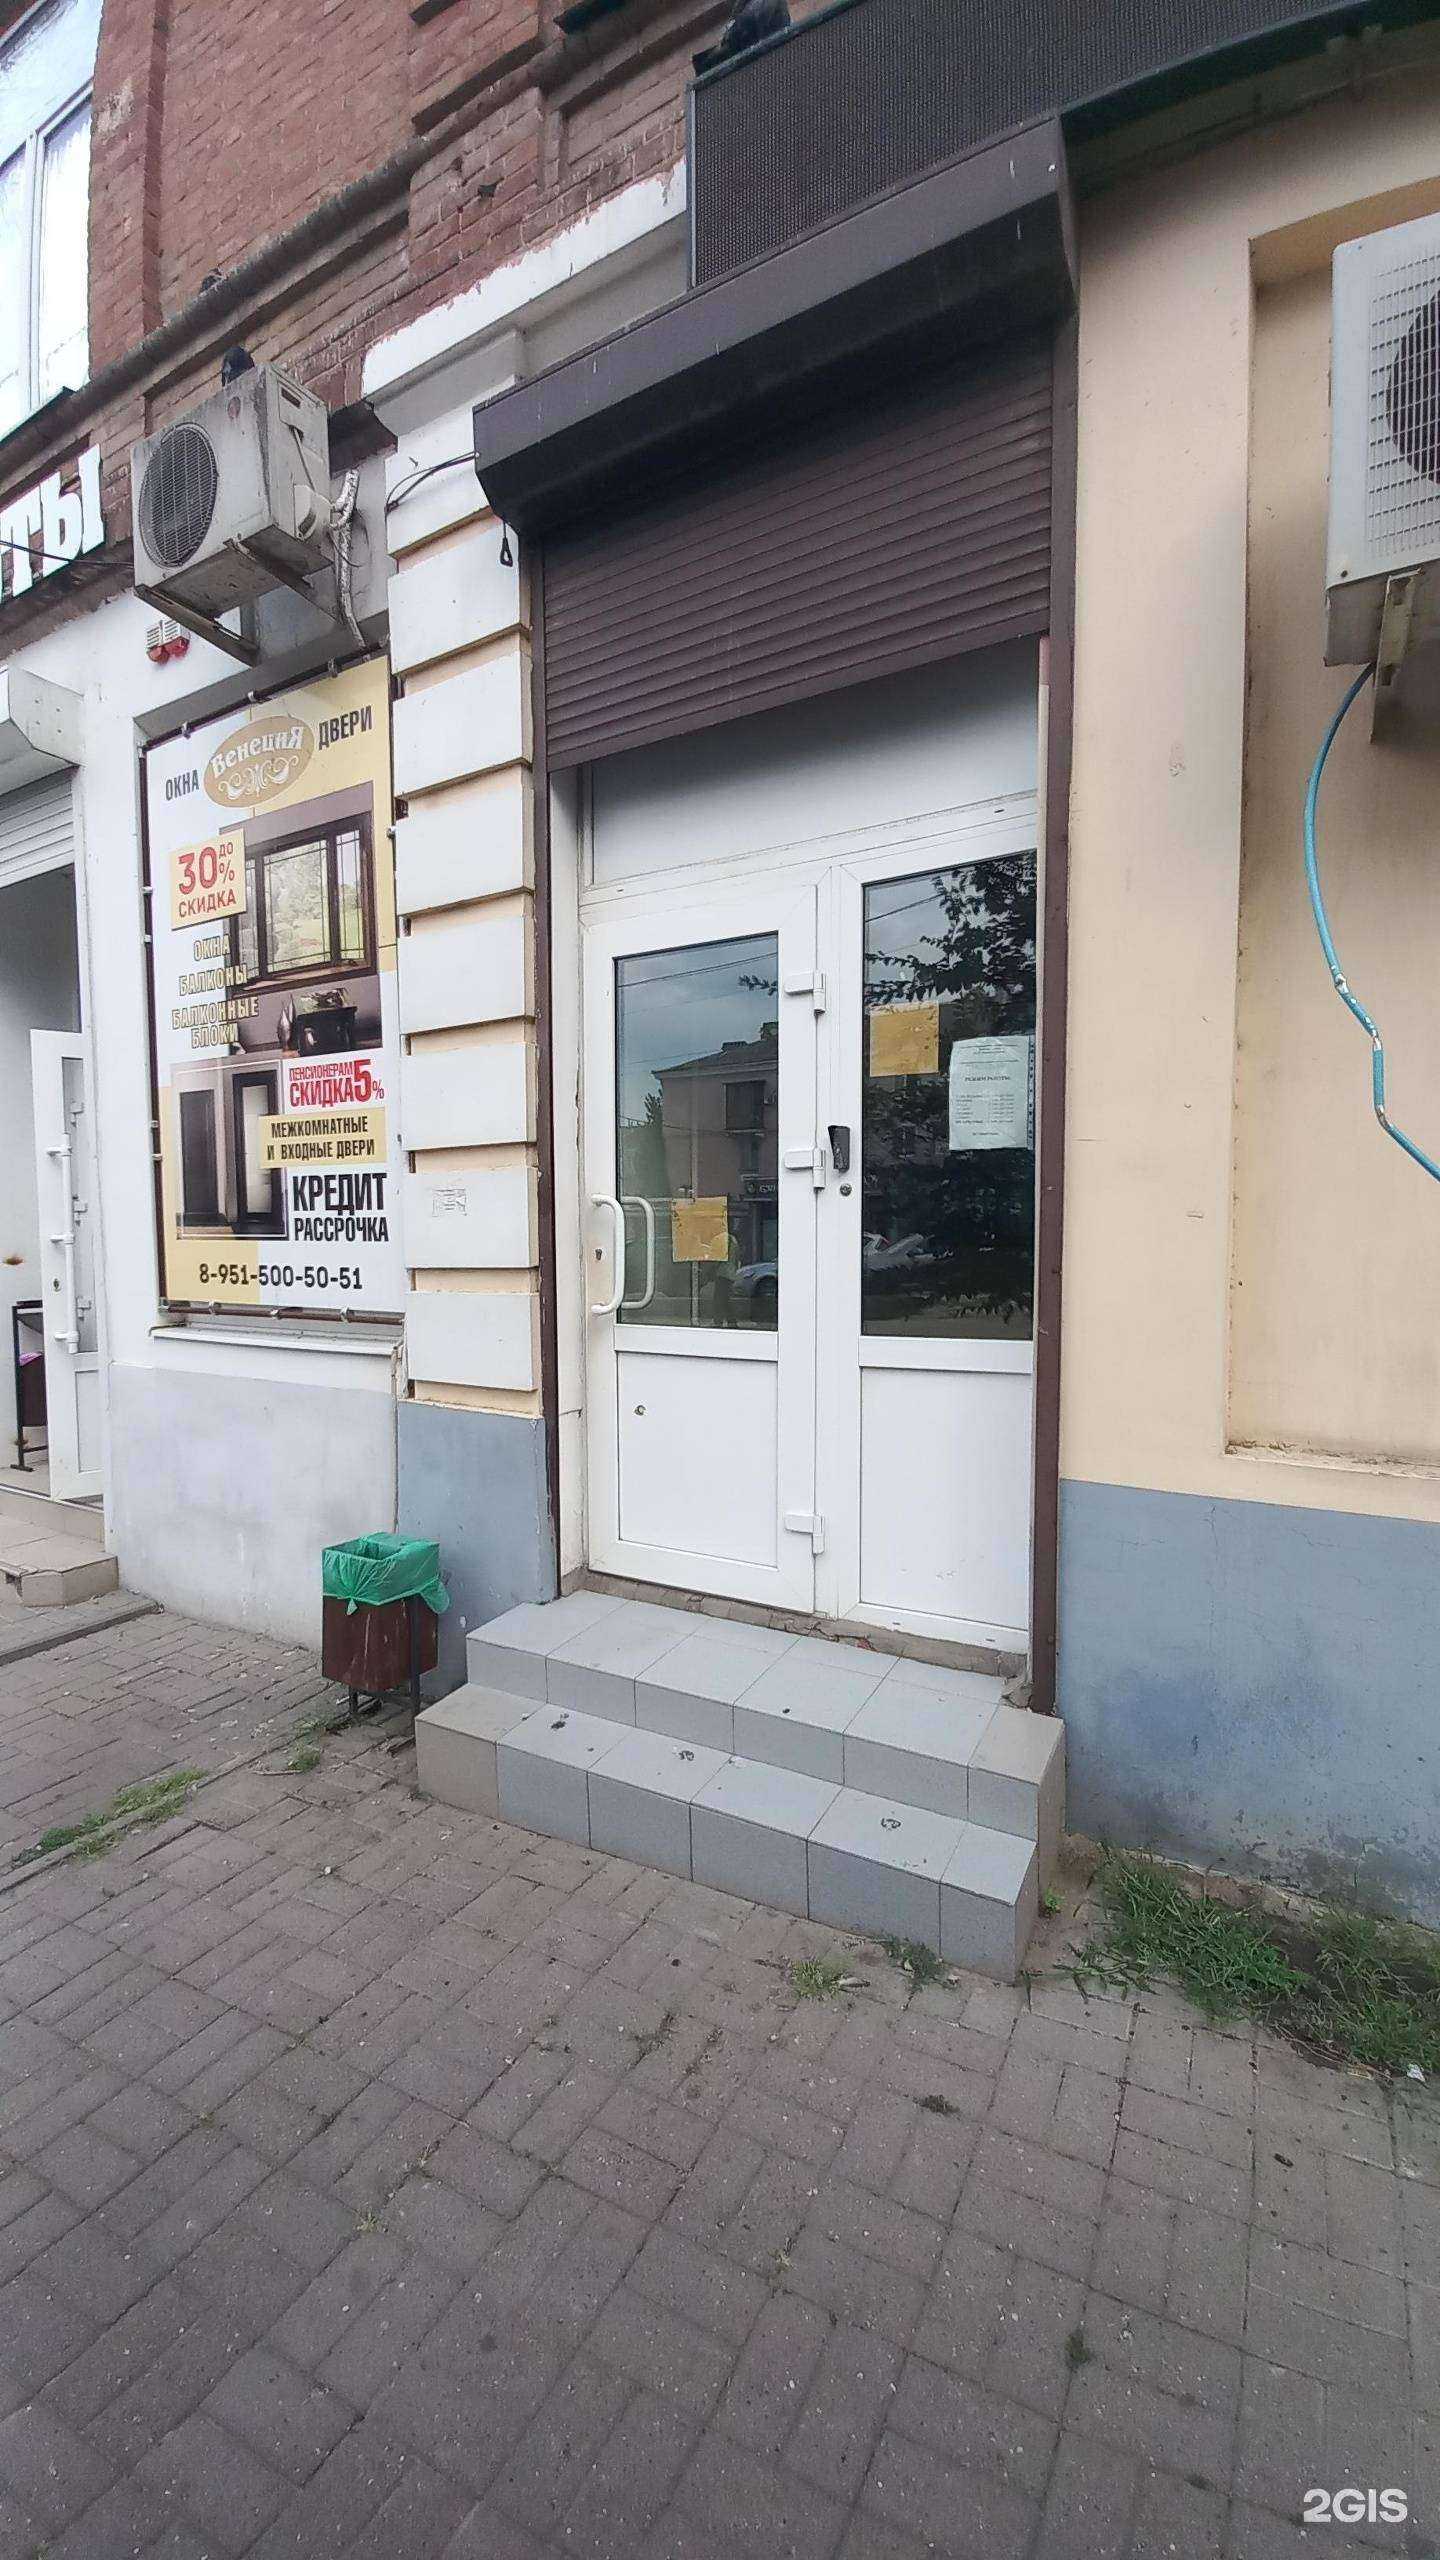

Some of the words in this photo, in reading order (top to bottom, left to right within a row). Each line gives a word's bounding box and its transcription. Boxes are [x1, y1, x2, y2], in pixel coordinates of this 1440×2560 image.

[0, 443, 104, 598] ТЫ
[318, 705, 372, 750] ДВЕРИ
[165, 769, 199, 801] ОКНА
[178, 888, 236, 918] СКИДКА
[193, 934, 230, 961] ОКНА
[179, 964, 247, 996] БАЛКОНЫ
[171, 997, 259, 1030] БАЛКОННЫЕ
[191, 1022, 239, 1049] БЛОКИ
[288, 1061, 354, 1081] ПЕНСИОНЕРАМ
[289, 1077, 355, 1108] СКИДКА
[271, 1116, 368, 1138] МЕЖКОМНАТНЫЕ
[267, 1145, 275, 1160] И
[281, 1141, 333, 1161] ВХОДНЫЕ
[336, 1139, 375, 1159] ДВЕРИ
[293, 1173, 387, 1216] КРЕДИТ
[294, 1216, 389, 1242] РАССРОЧКА
[199, 1263, 363, 1290] 8-951-500-50-51
